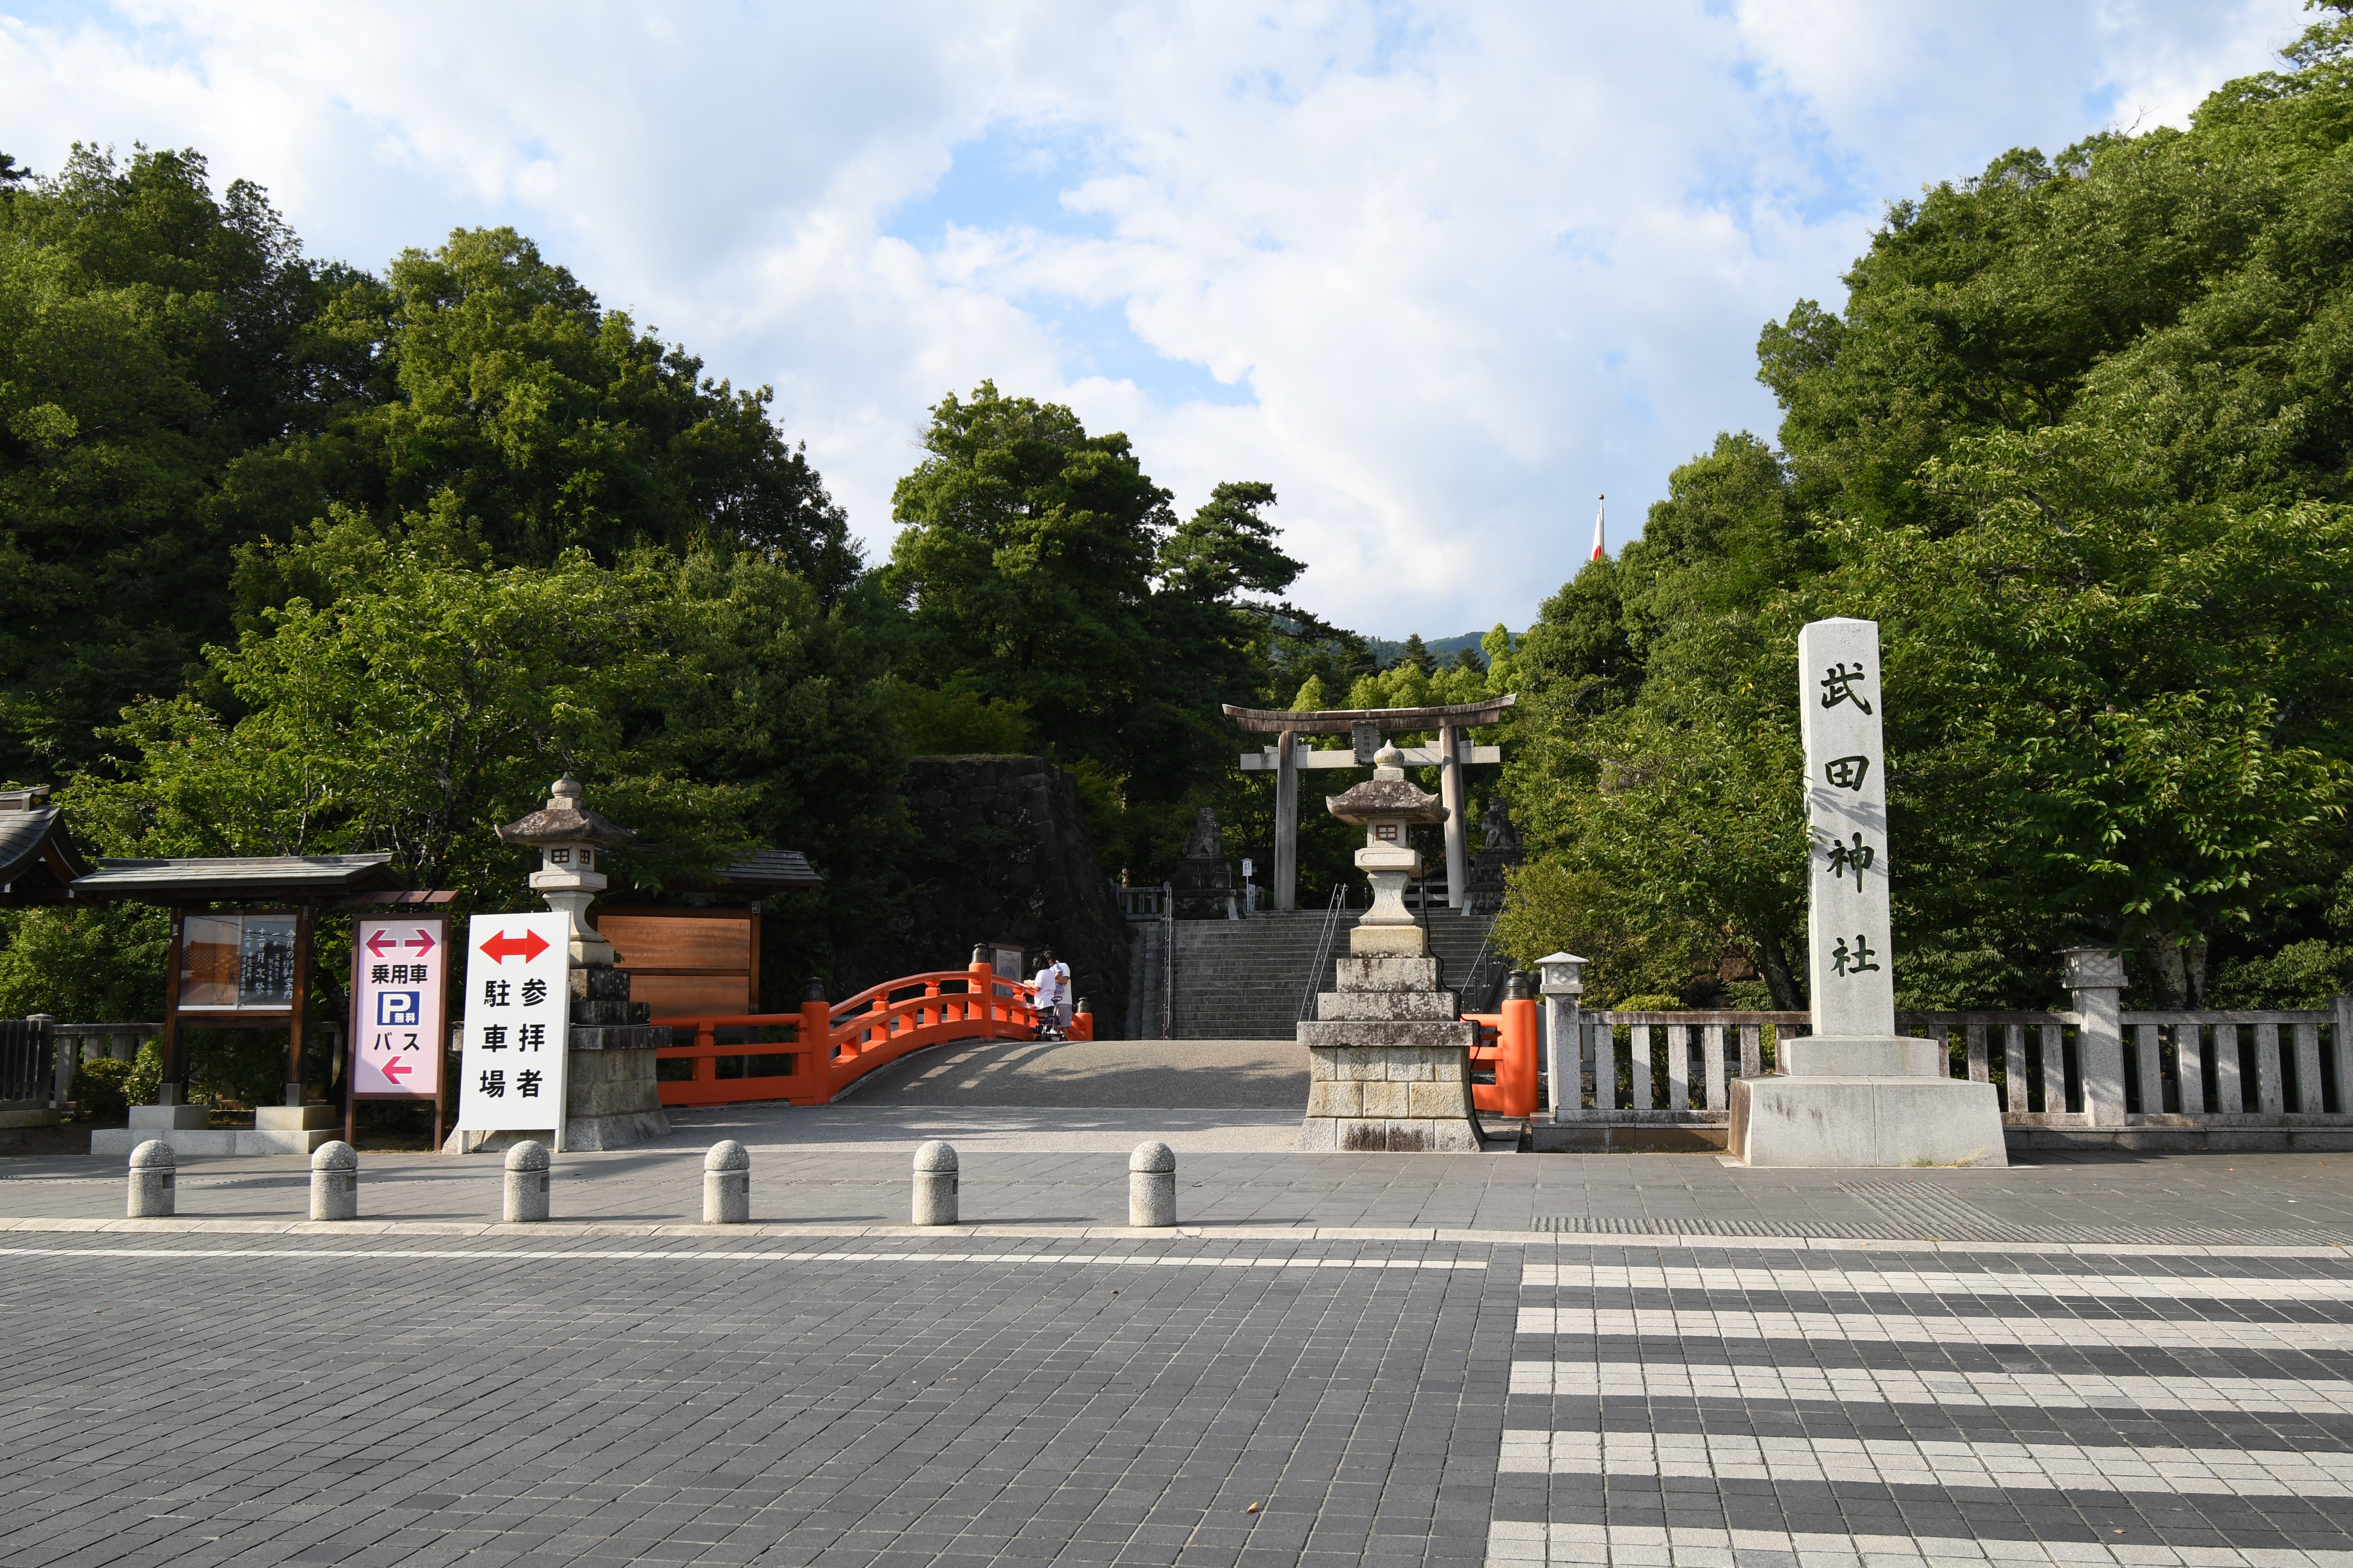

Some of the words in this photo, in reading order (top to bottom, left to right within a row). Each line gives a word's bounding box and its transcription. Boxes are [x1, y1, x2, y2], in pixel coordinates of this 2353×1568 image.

[1820, 662, 1880, 978] 武田神社
[257, 928, 266, 948] 十二日
[255, 952, 266, 994] 月次祭
[371, 964, 428, 985] 乗用車
[382, 993, 411, 1024] P
[394, 1012, 416, 1023] 無料
[373, 1032, 420, 1051] バス
[479, 979, 511, 1098] 駐車場
[516, 978, 547, 1098] 参拝者
